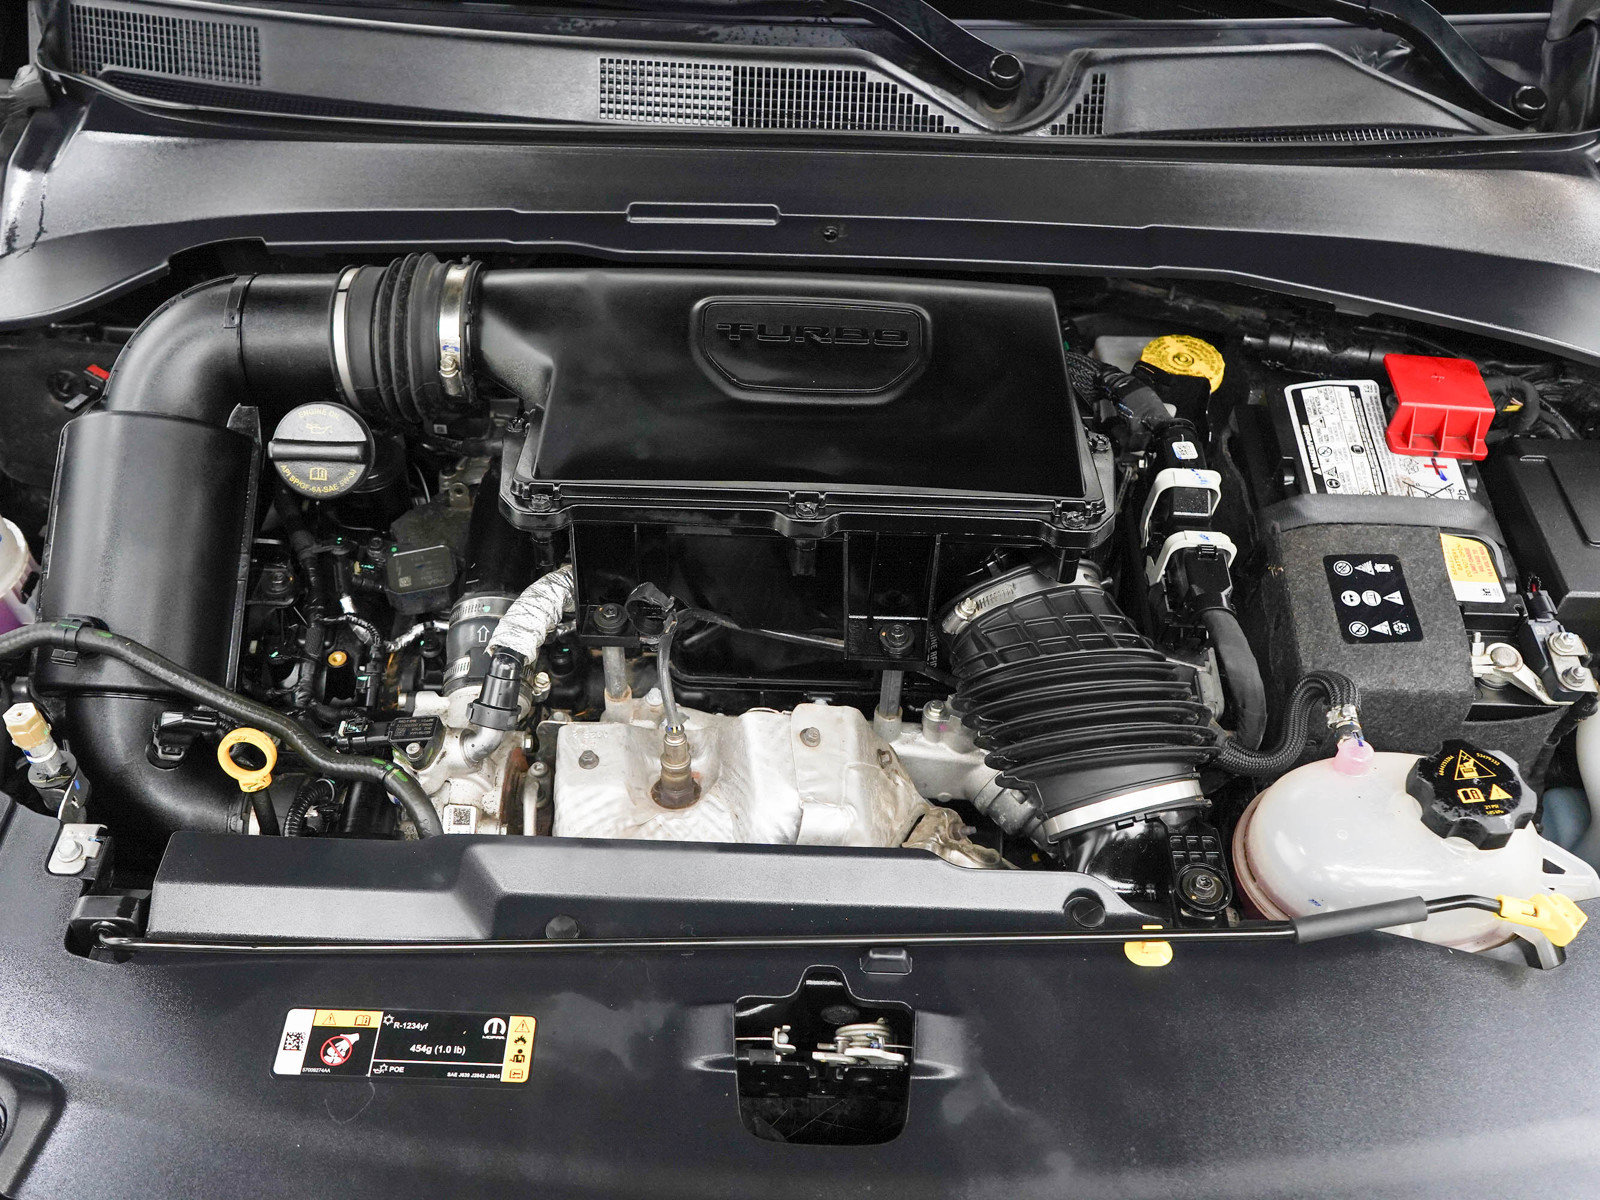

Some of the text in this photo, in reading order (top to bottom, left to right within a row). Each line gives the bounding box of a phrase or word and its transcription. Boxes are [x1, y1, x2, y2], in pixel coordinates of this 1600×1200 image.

[715, 322, 910, 347] TURBO
[297, 407, 341, 419] ENGINE OIL
[279, 464, 292, 477] API
[393, 1021, 429, 1031] R-1234yf
[409, 1044, 466, 1056] 454g (1.0 lb)
